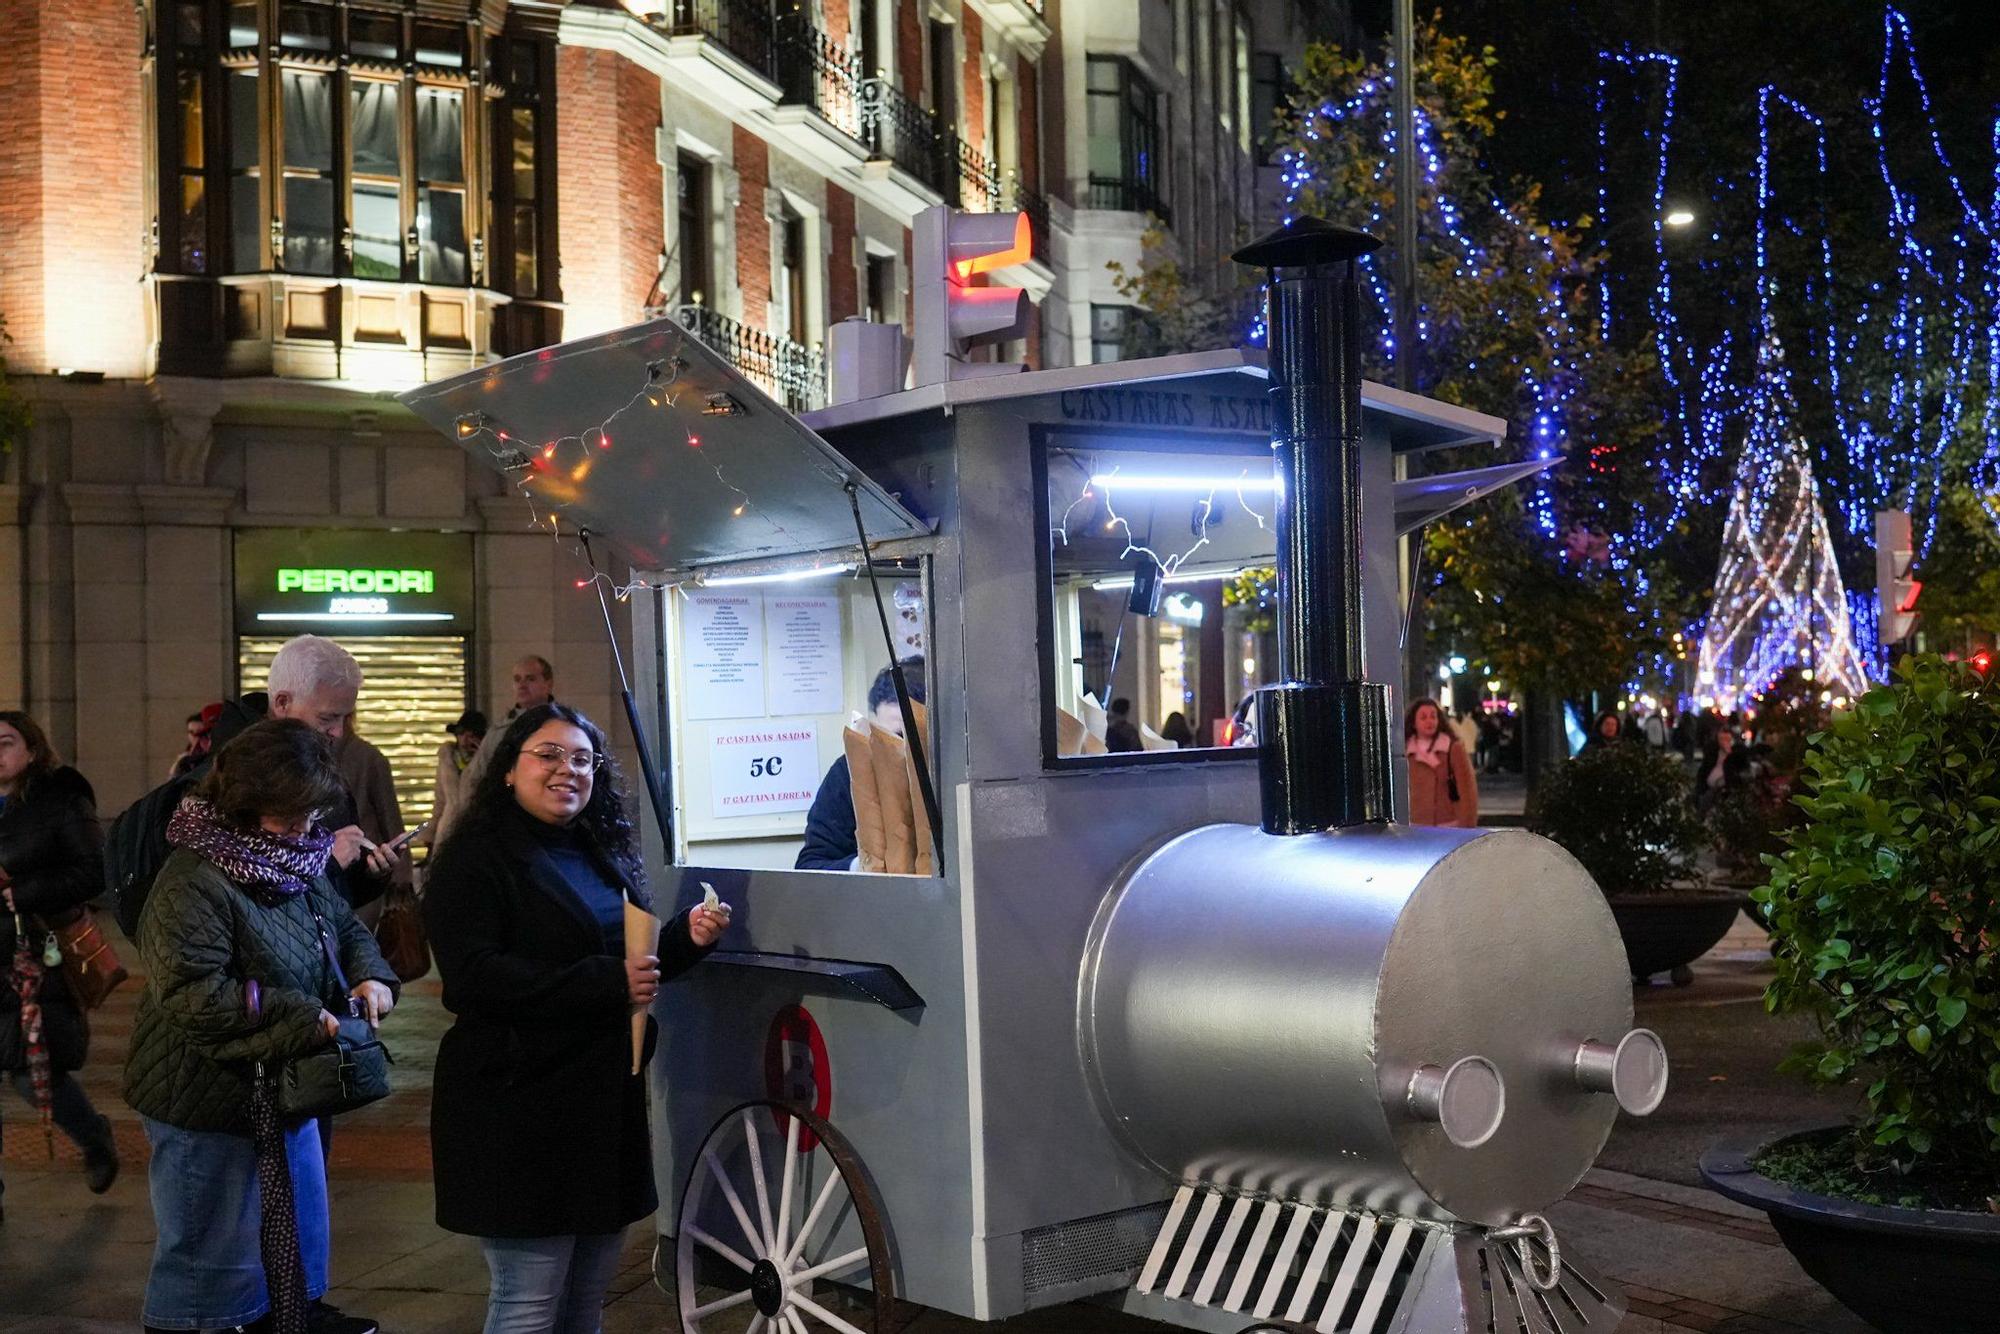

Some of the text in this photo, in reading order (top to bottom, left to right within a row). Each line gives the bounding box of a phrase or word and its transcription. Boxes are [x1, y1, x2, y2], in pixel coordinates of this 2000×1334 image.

[277, 569, 434, 593] PERODRI
[777, 731, 812, 741] ASADAS
[723, 796, 731, 805] 17
